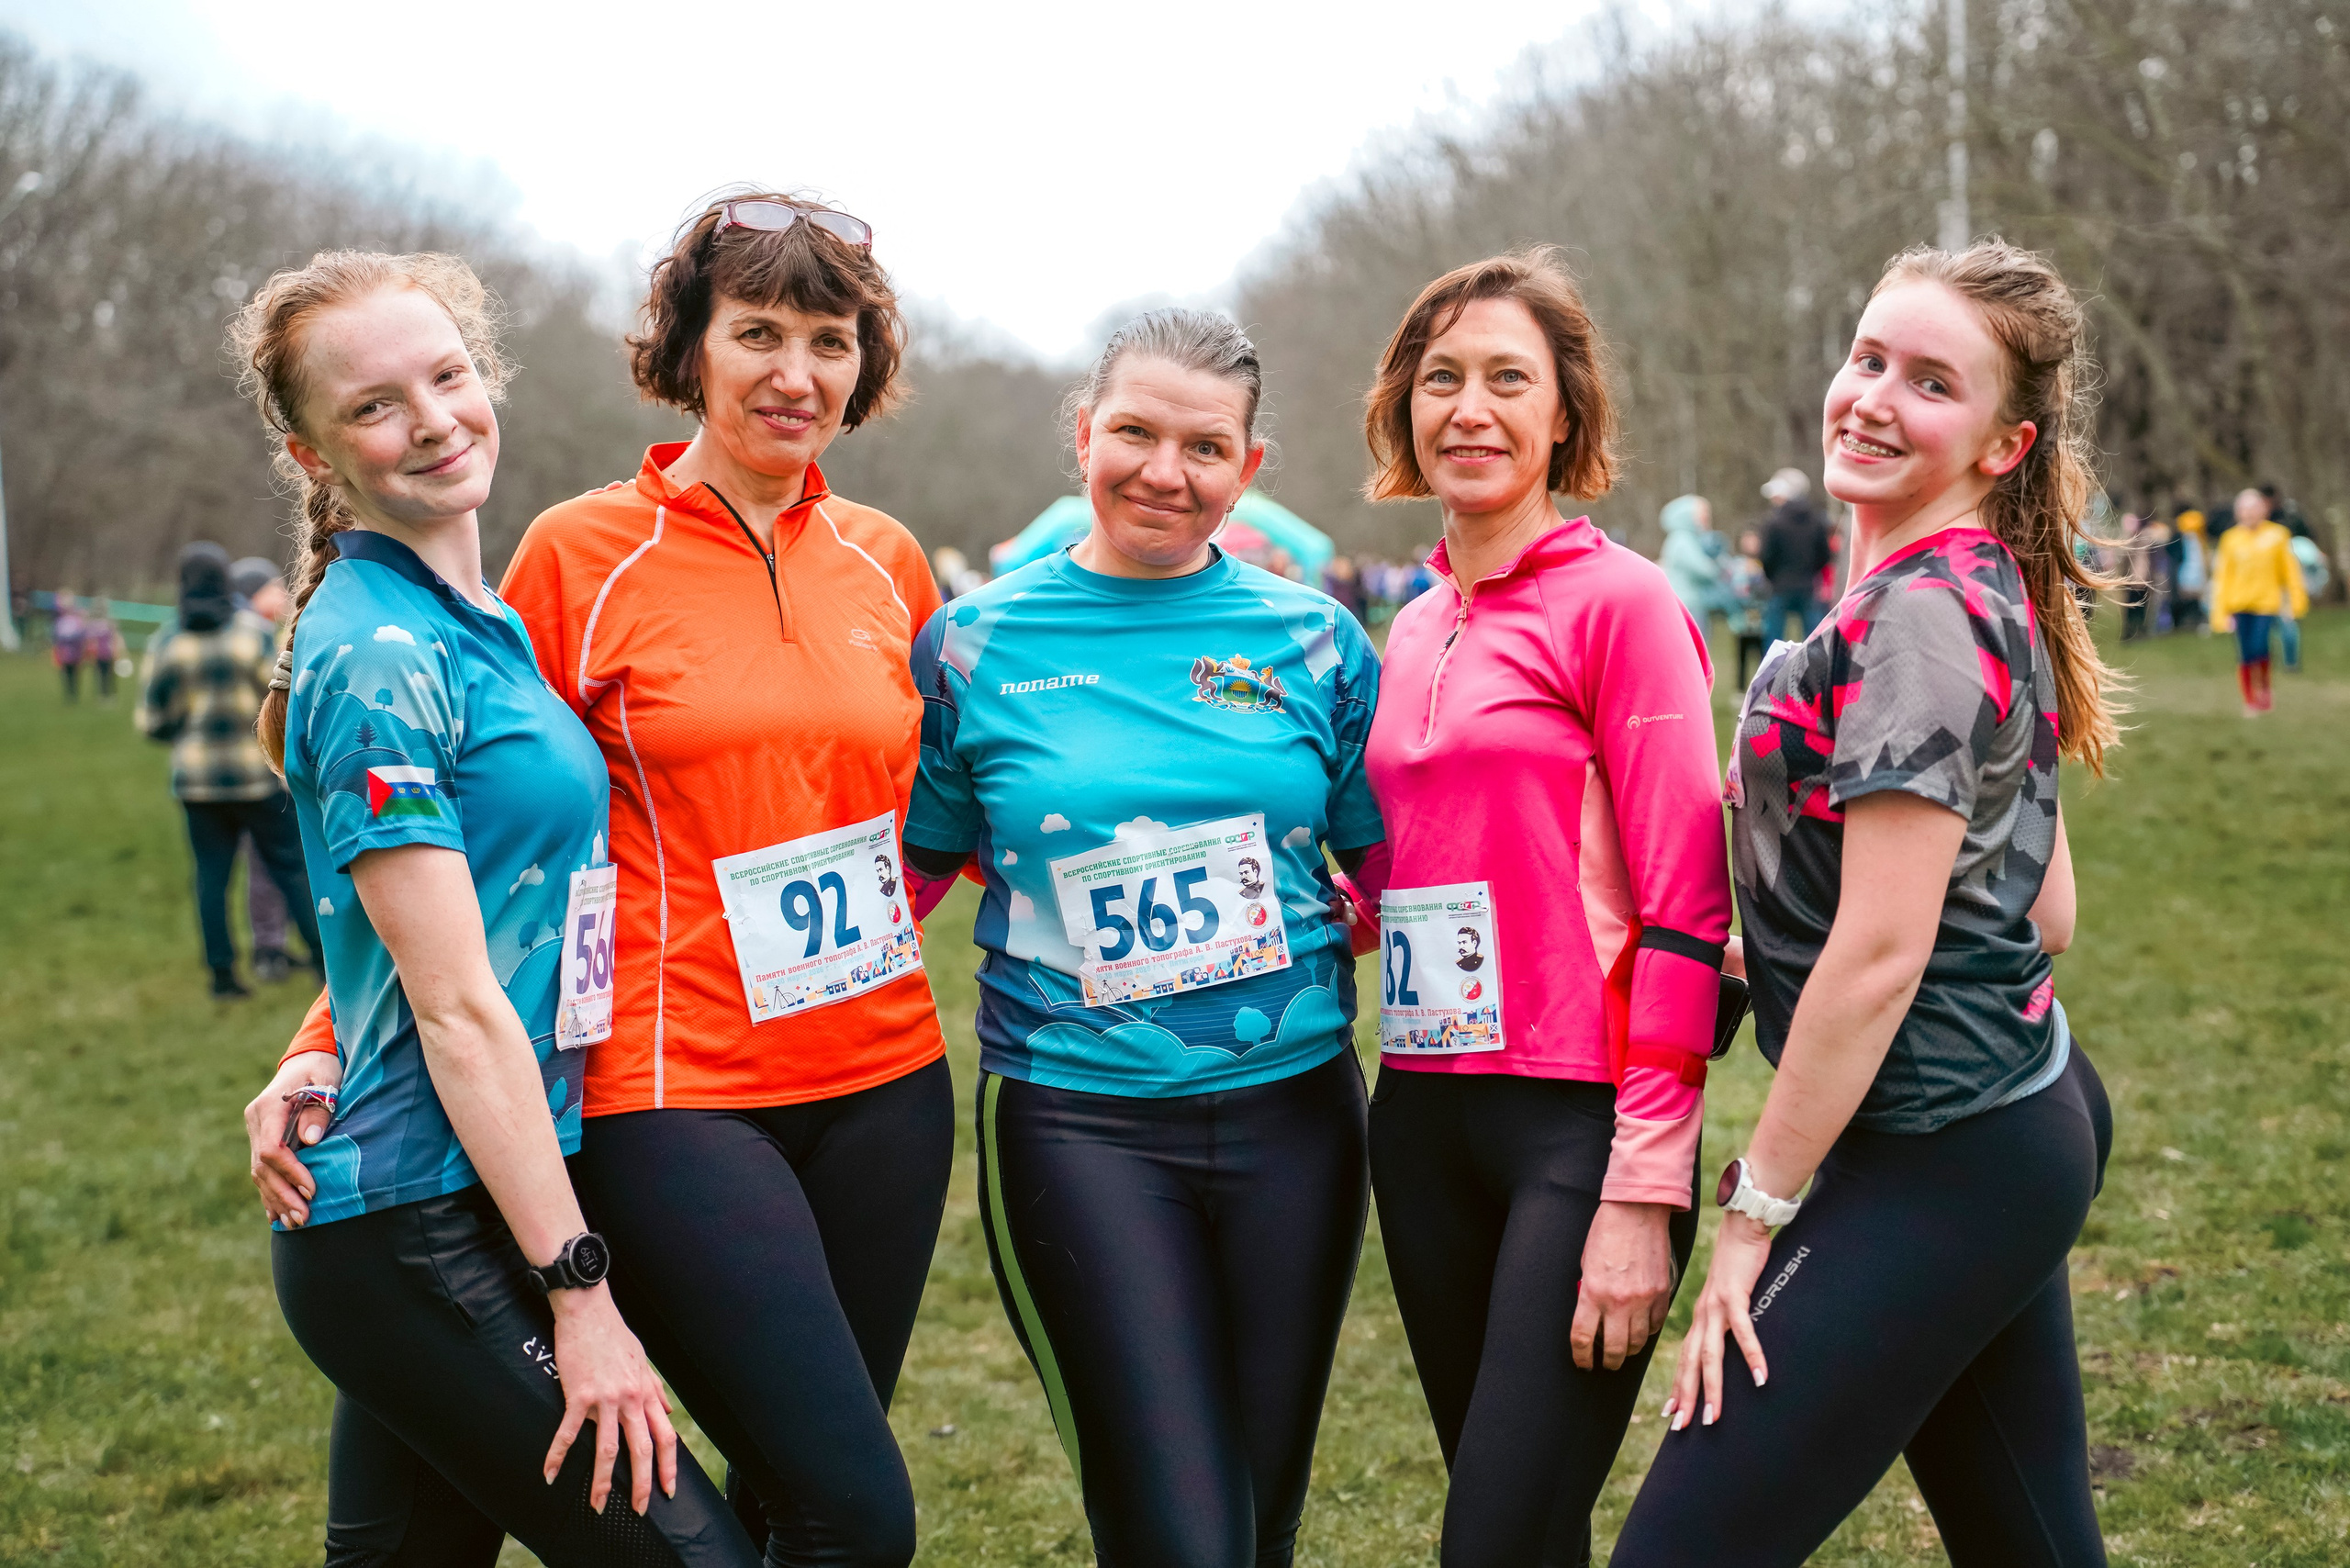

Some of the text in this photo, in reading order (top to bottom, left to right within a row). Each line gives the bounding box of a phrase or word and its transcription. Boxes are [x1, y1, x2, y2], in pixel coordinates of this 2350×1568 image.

[999, 674, 1100, 696] noname
[1642, 713, 1684, 723] OUTVENTURE
[730, 859, 789, 880] ВСЕРОССИЙСКИЕ
[790, 847, 830, 866] СПОРТИВНЫЕ
[830, 834, 867, 855] СОРЕВНОВАНИЯ
[1062, 857, 1122, 879] ВСЕРОССИЙСКИЕ
[1123, 846, 1168, 864] СПОРТИВНЫЕ
[1081, 850, 1207, 883] ПО СПОРТИВНОМУ ОРИЕНТИРОВАНИЮ
[750, 877, 760, 887] ПО
[761, 865, 811, 883] СПОРТИВНОМУ
[780, 870, 862, 958] 92
[1089, 866, 1220, 961] 565
[755, 969, 787, 983] Памяти
[788, 958, 822, 974] военного
[824, 947, 856, 965] топографа
[1114, 957, 1149, 969] военного
[1151, 947, 1193, 962] топографа
[1214, 934, 1253, 950] Пастухова
[1386, 928, 1419, 1006] 82
[1427, 1007, 1462, 1017] Пастухова
[1750, 1245, 1811, 1322] NORDSKI
